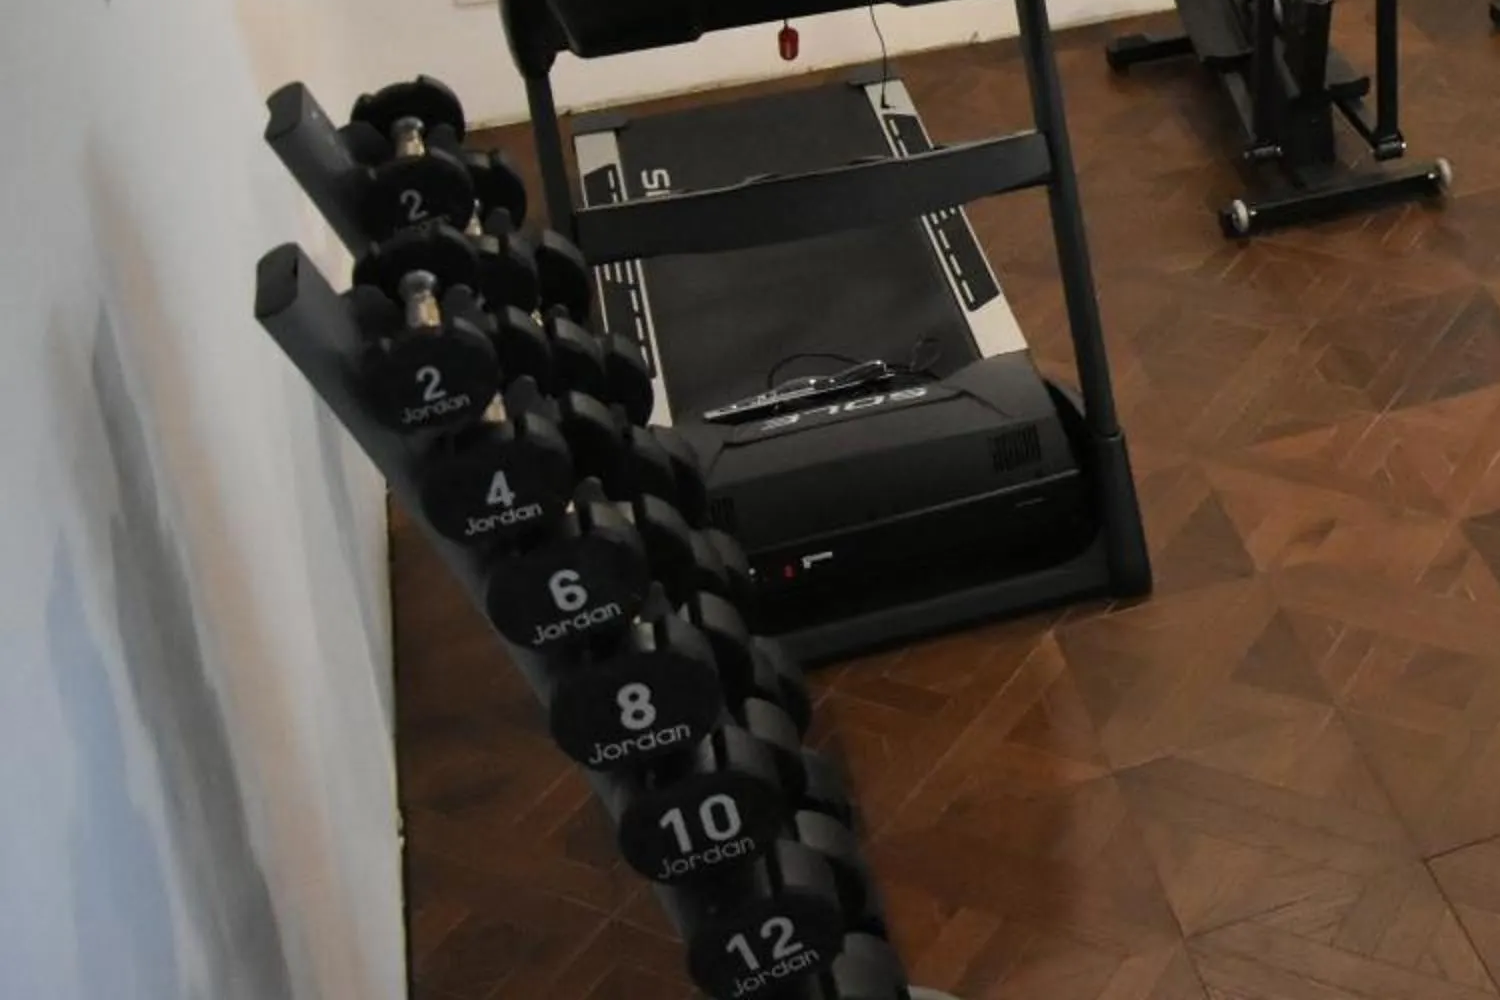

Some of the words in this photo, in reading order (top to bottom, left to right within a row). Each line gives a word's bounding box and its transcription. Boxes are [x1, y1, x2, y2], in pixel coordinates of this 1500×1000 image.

[400, 189, 428, 221] 2
[416, 366, 446, 401] 2
[402, 393, 471, 424] Jordan
[486, 470, 516, 506] 4
[465, 503, 543, 536] Jordan
[548, 569, 588, 612] 6
[532, 602, 621, 645] Jordan
[617, 682, 656, 730] 8
[589, 724, 690, 764] Jordan
[660, 793, 741, 853] 10
[658, 837, 755, 879] Jordan
[726, 916, 803, 971] 12
[732, 948, 819, 998] Jordan
